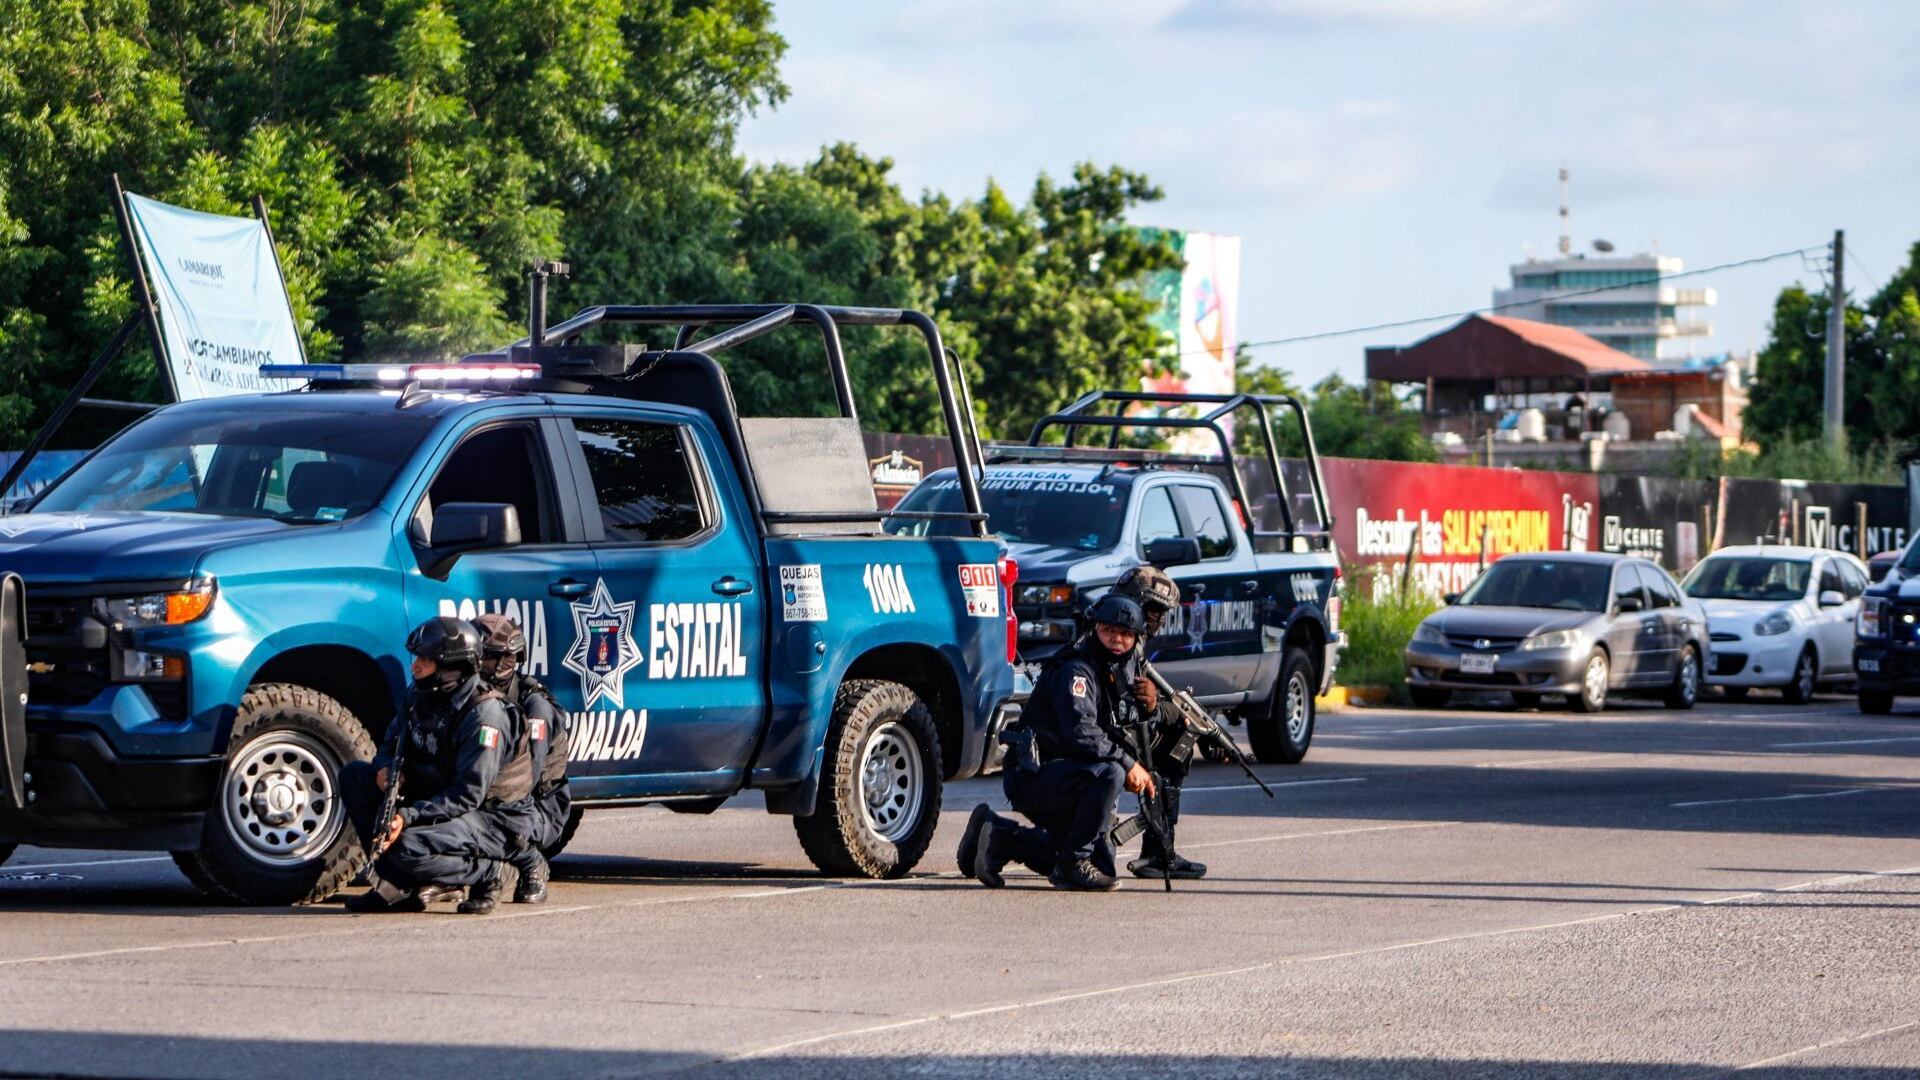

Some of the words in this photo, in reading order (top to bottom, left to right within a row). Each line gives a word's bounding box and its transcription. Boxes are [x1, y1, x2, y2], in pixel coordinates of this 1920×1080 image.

[1421, 509, 1442, 554] las
[1604, 517, 1664, 550] VICENTE
[1807, 510, 1905, 552] VICNTE
[782, 567, 820, 579] QUEJAS
[863, 563, 915, 613] 100A
[961, 567, 995, 586] 911
[1210, 601, 1254, 632] MUNICIPAL
[649, 603, 746, 679] ESTATAL
